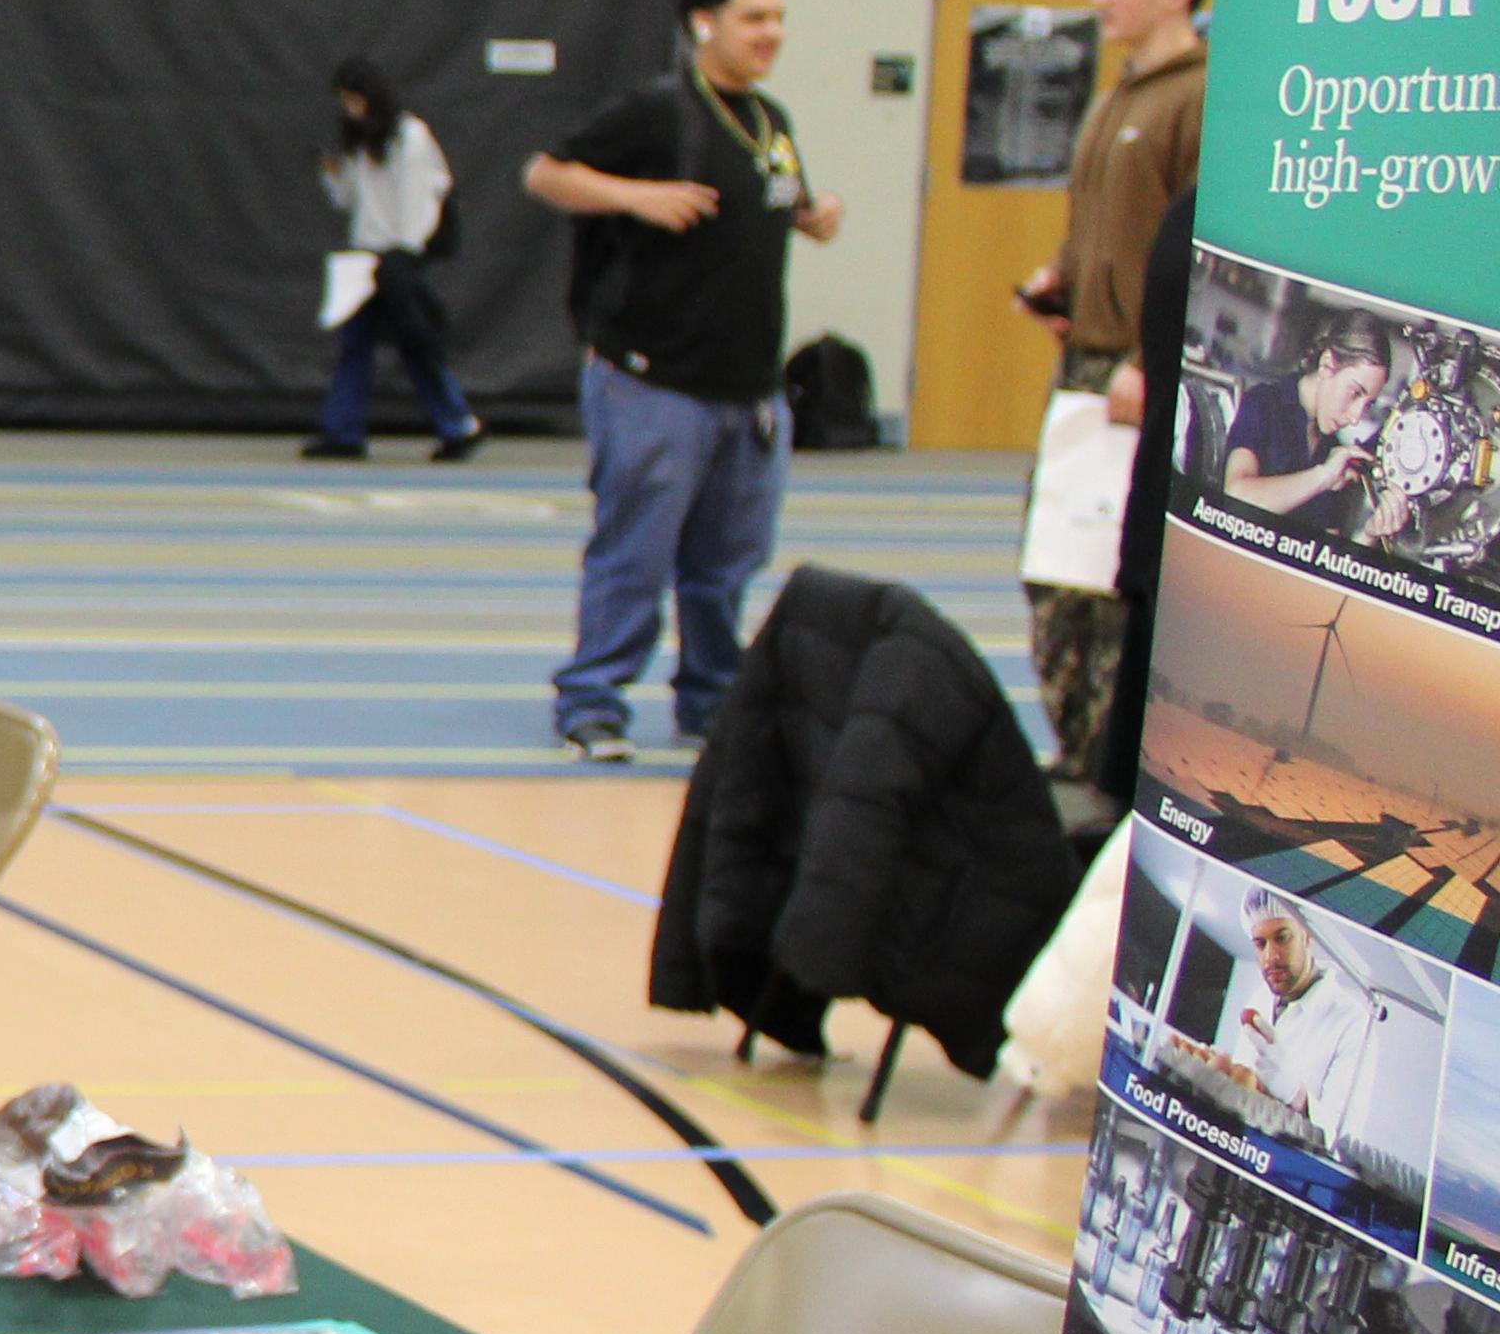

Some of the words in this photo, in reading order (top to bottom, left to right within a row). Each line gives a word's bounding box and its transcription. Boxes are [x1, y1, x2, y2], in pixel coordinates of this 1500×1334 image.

[1279, 65, 1500, 131] Opportun
[1268, 139, 1500, 210] high-grow
[1192, 496, 1275, 549] Aerospace
[1278, 528, 1313, 564] and
[1315, 544, 1429, 604] Automotive
[1158, 796, 1214, 845] Energy
[1125, 1072, 1166, 1114] Food
[1167, 1097, 1271, 1175] Processing
